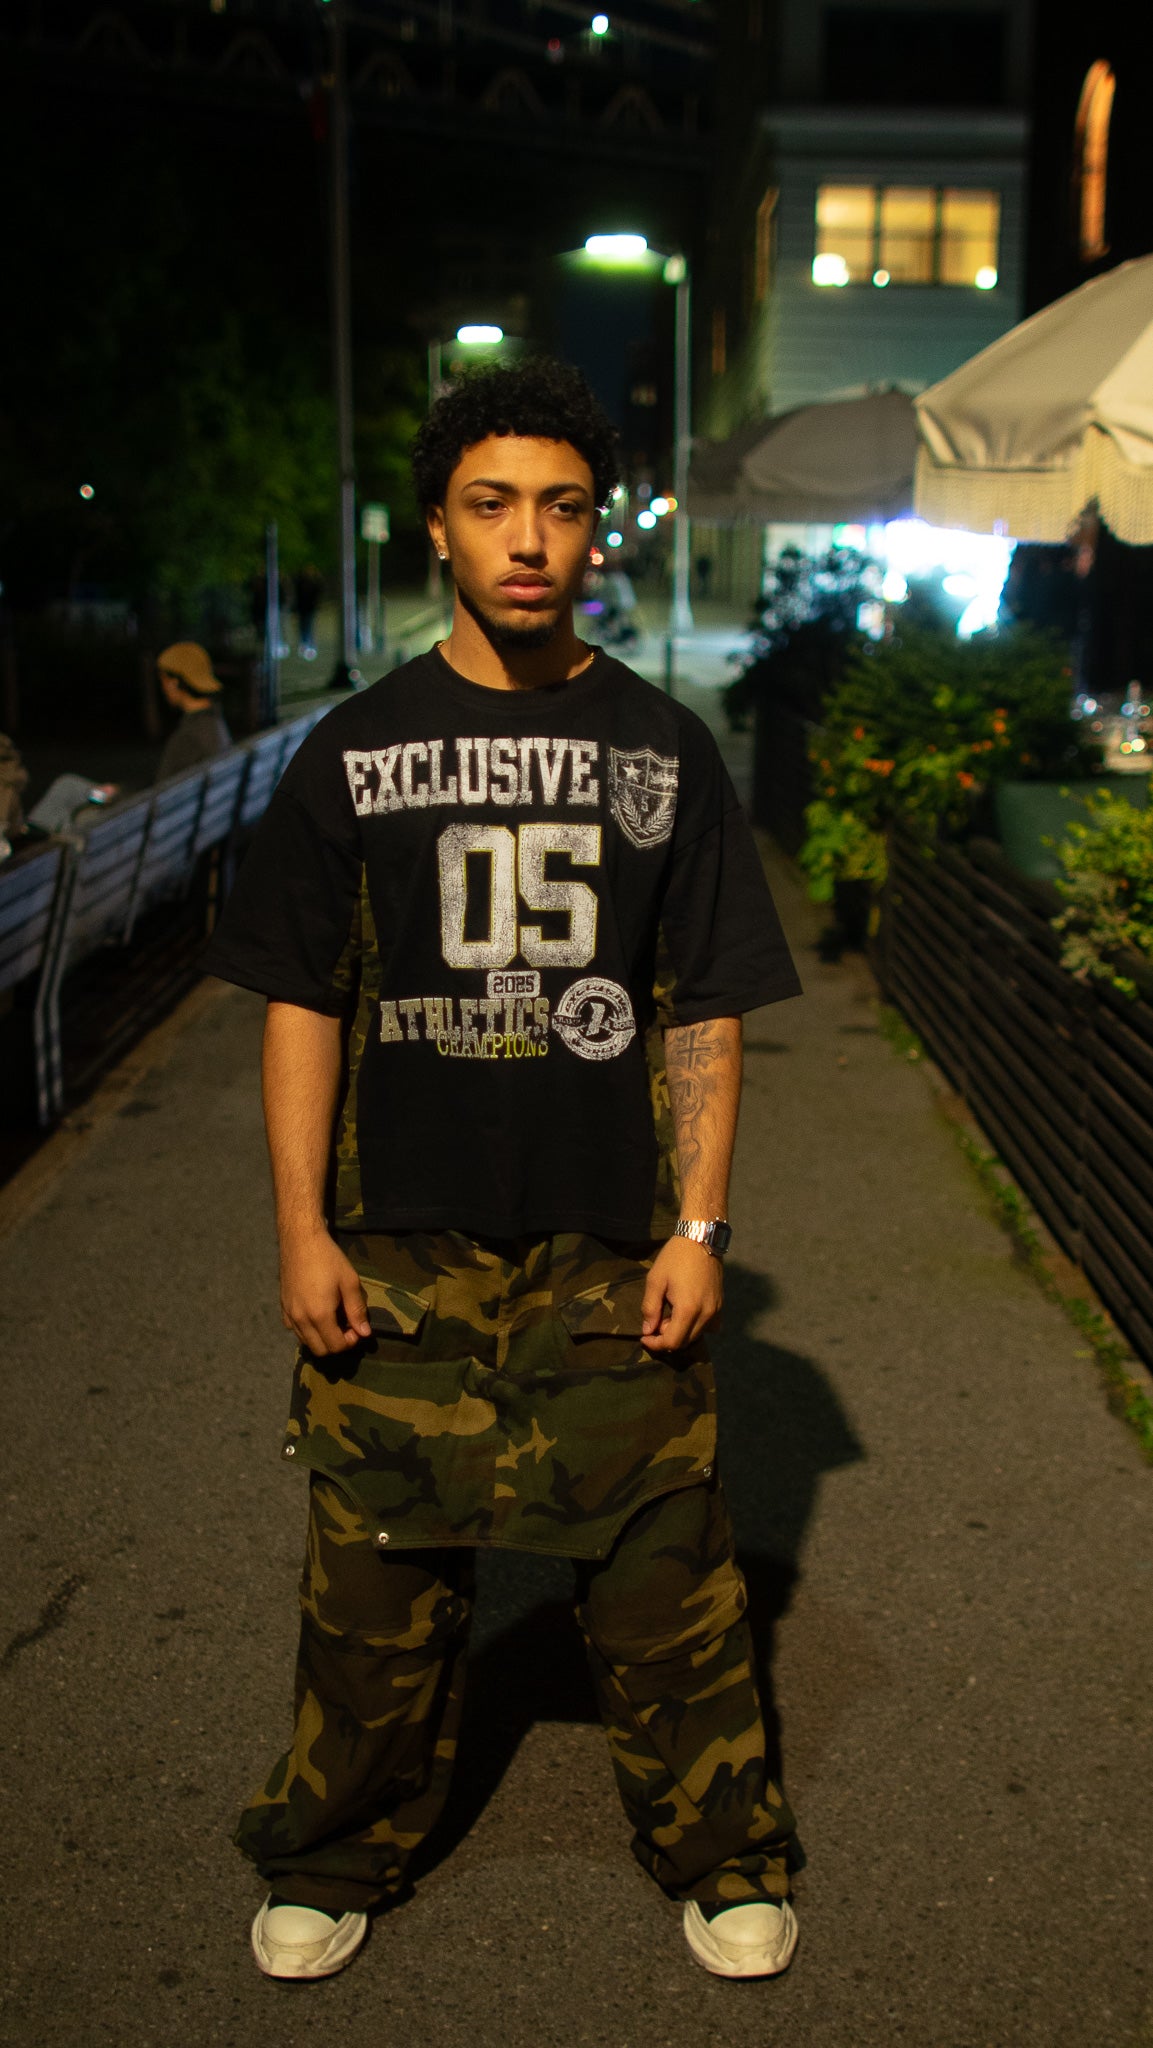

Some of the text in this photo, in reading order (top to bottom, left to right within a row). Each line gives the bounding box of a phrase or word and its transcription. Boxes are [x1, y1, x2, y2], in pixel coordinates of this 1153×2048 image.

[343, 737, 600, 816] EXCLUSIVE
[438, 823, 602, 969] 05
[493, 975, 535, 994] 2025
[379, 997, 551, 1043] ATHLETICS
[436, 1030, 549, 1060] CHAMPIONS
